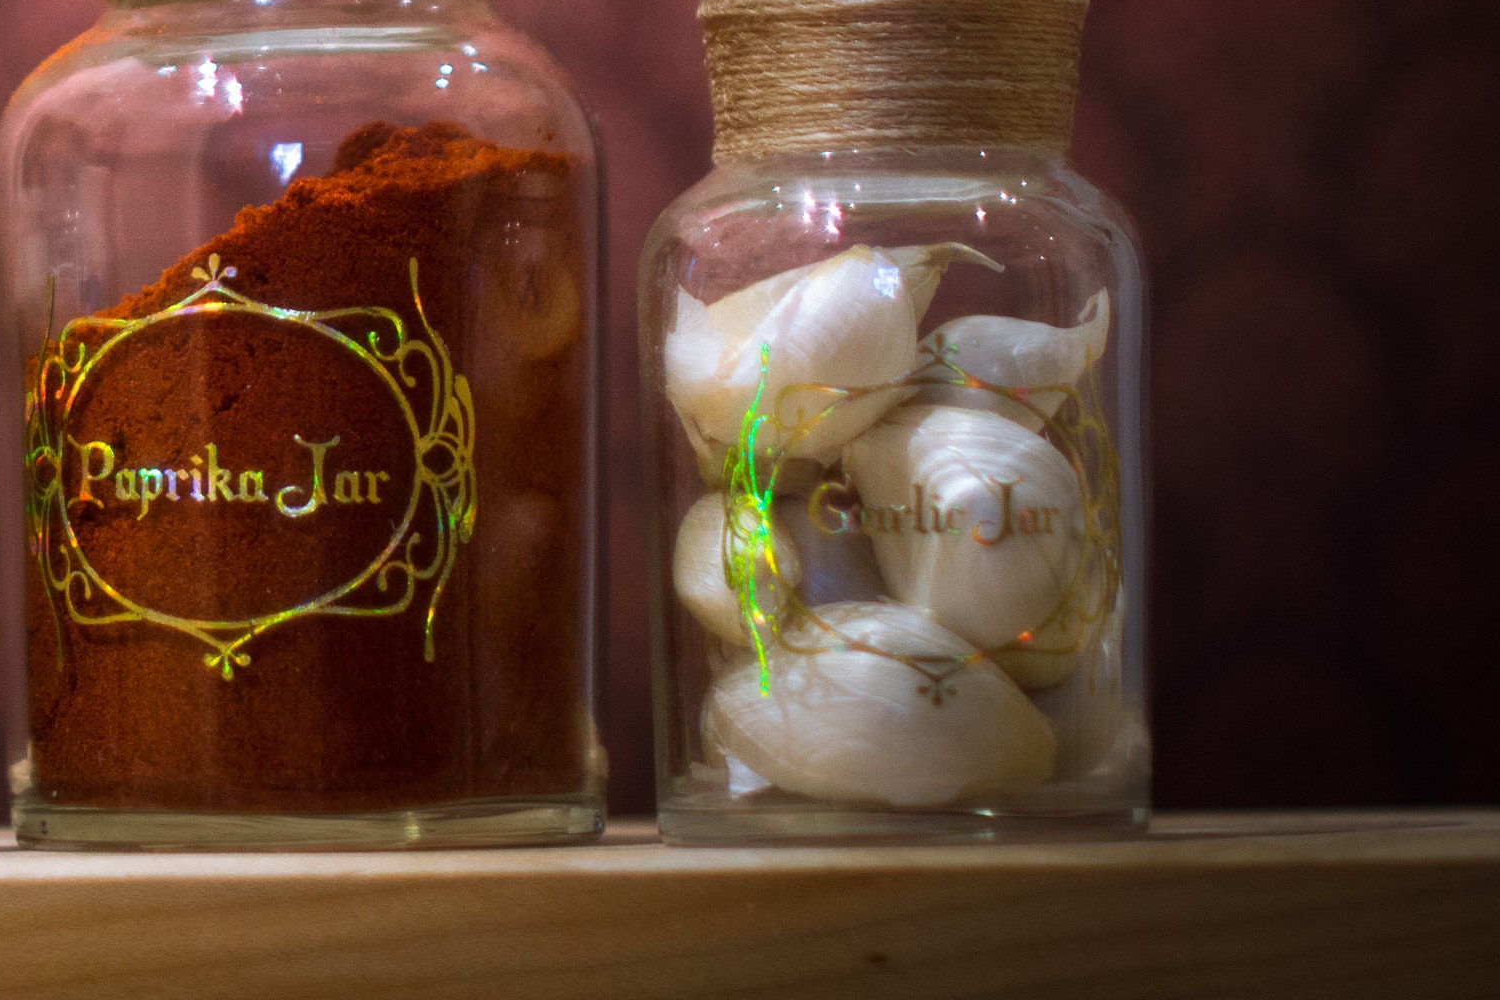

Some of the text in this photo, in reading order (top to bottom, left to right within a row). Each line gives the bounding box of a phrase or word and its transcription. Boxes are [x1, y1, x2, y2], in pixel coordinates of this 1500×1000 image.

[67, 434, 390, 521] Paprika Jar
[807, 473, 1060, 547] Garlic Jar
